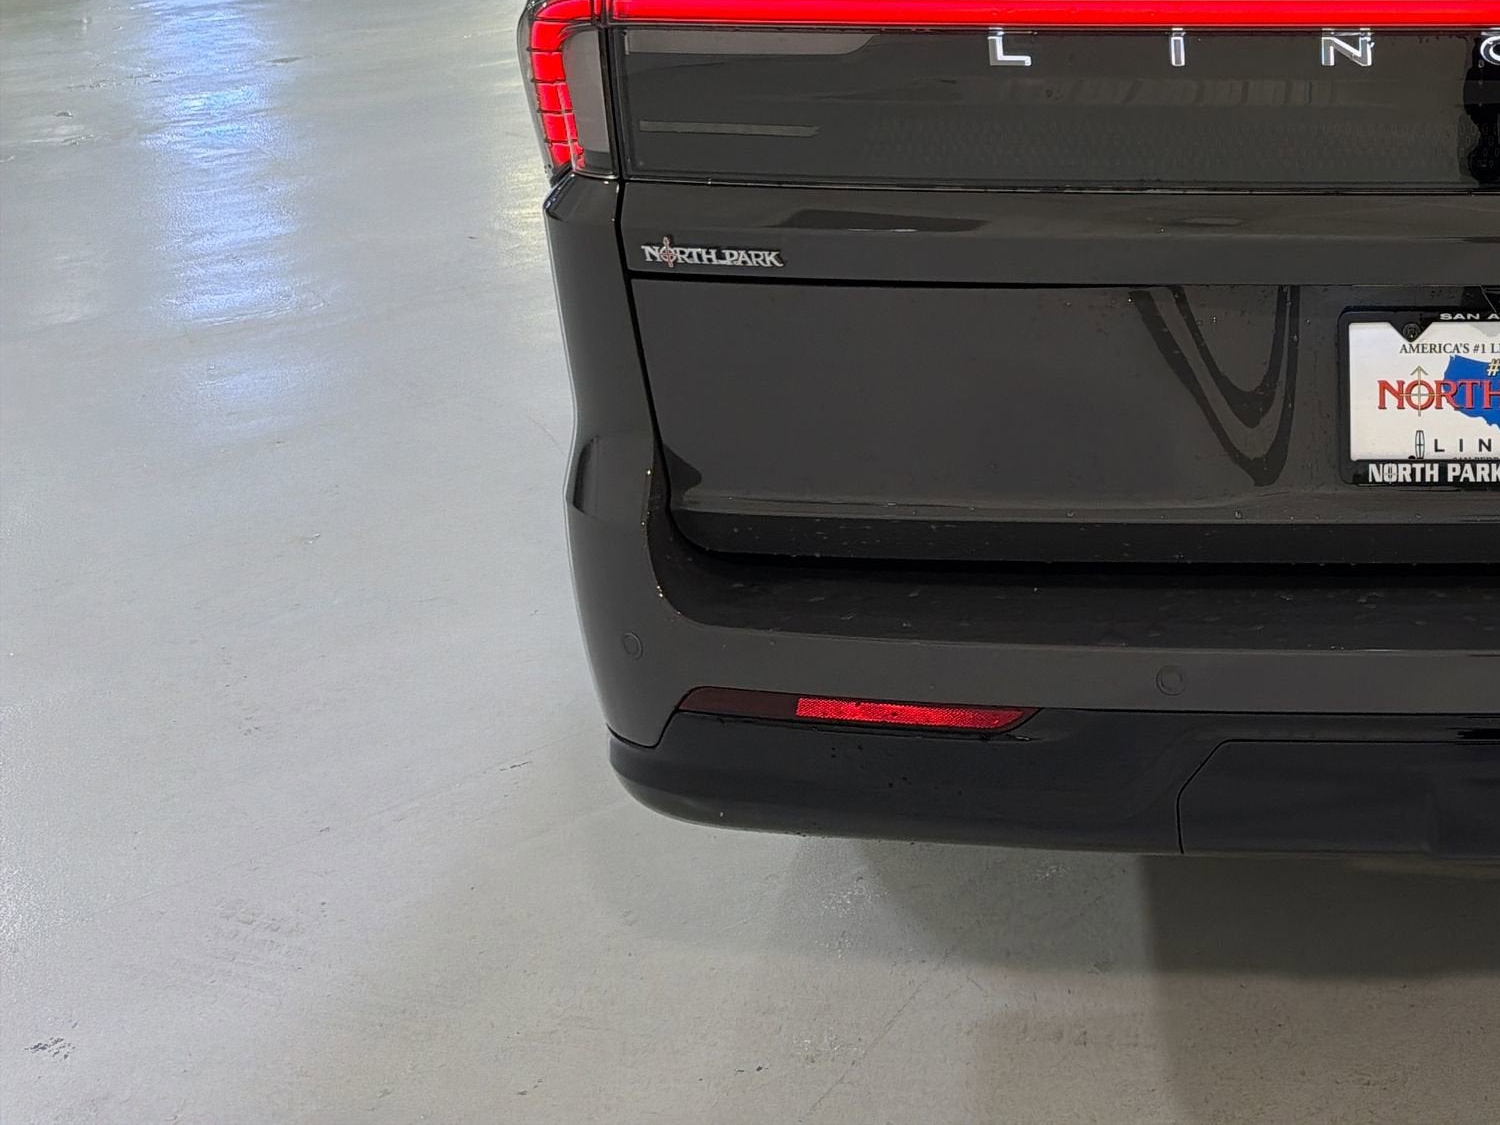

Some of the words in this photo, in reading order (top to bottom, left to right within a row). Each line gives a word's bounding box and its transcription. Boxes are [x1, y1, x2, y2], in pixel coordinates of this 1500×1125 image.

[641, 244, 718, 265] NORTH
[718, 248, 784, 268] PARK
[1439, 312, 1480, 321] SAN
[1399, 342, 1470, 355] AMERICA'S
[1473, 342, 1486, 355] #1
[1368, 462, 1439, 483] NORTH
